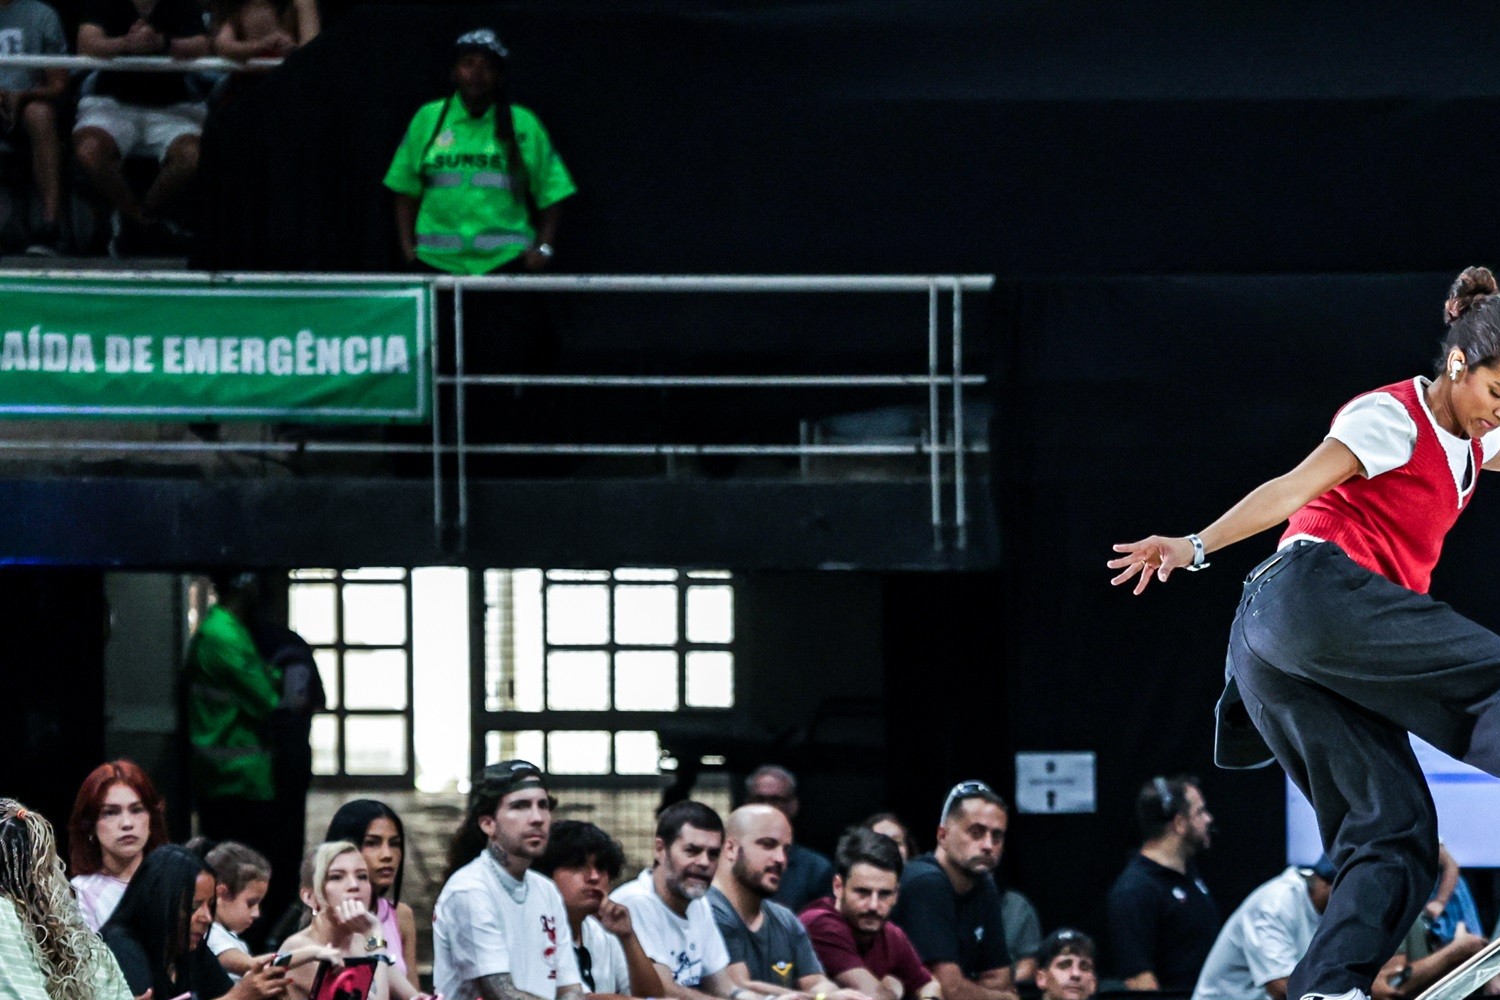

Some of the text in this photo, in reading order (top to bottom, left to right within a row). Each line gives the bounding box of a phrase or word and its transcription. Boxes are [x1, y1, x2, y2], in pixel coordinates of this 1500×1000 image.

[0, 325, 409, 375] AÍDA DE EMERGÊNCIA
